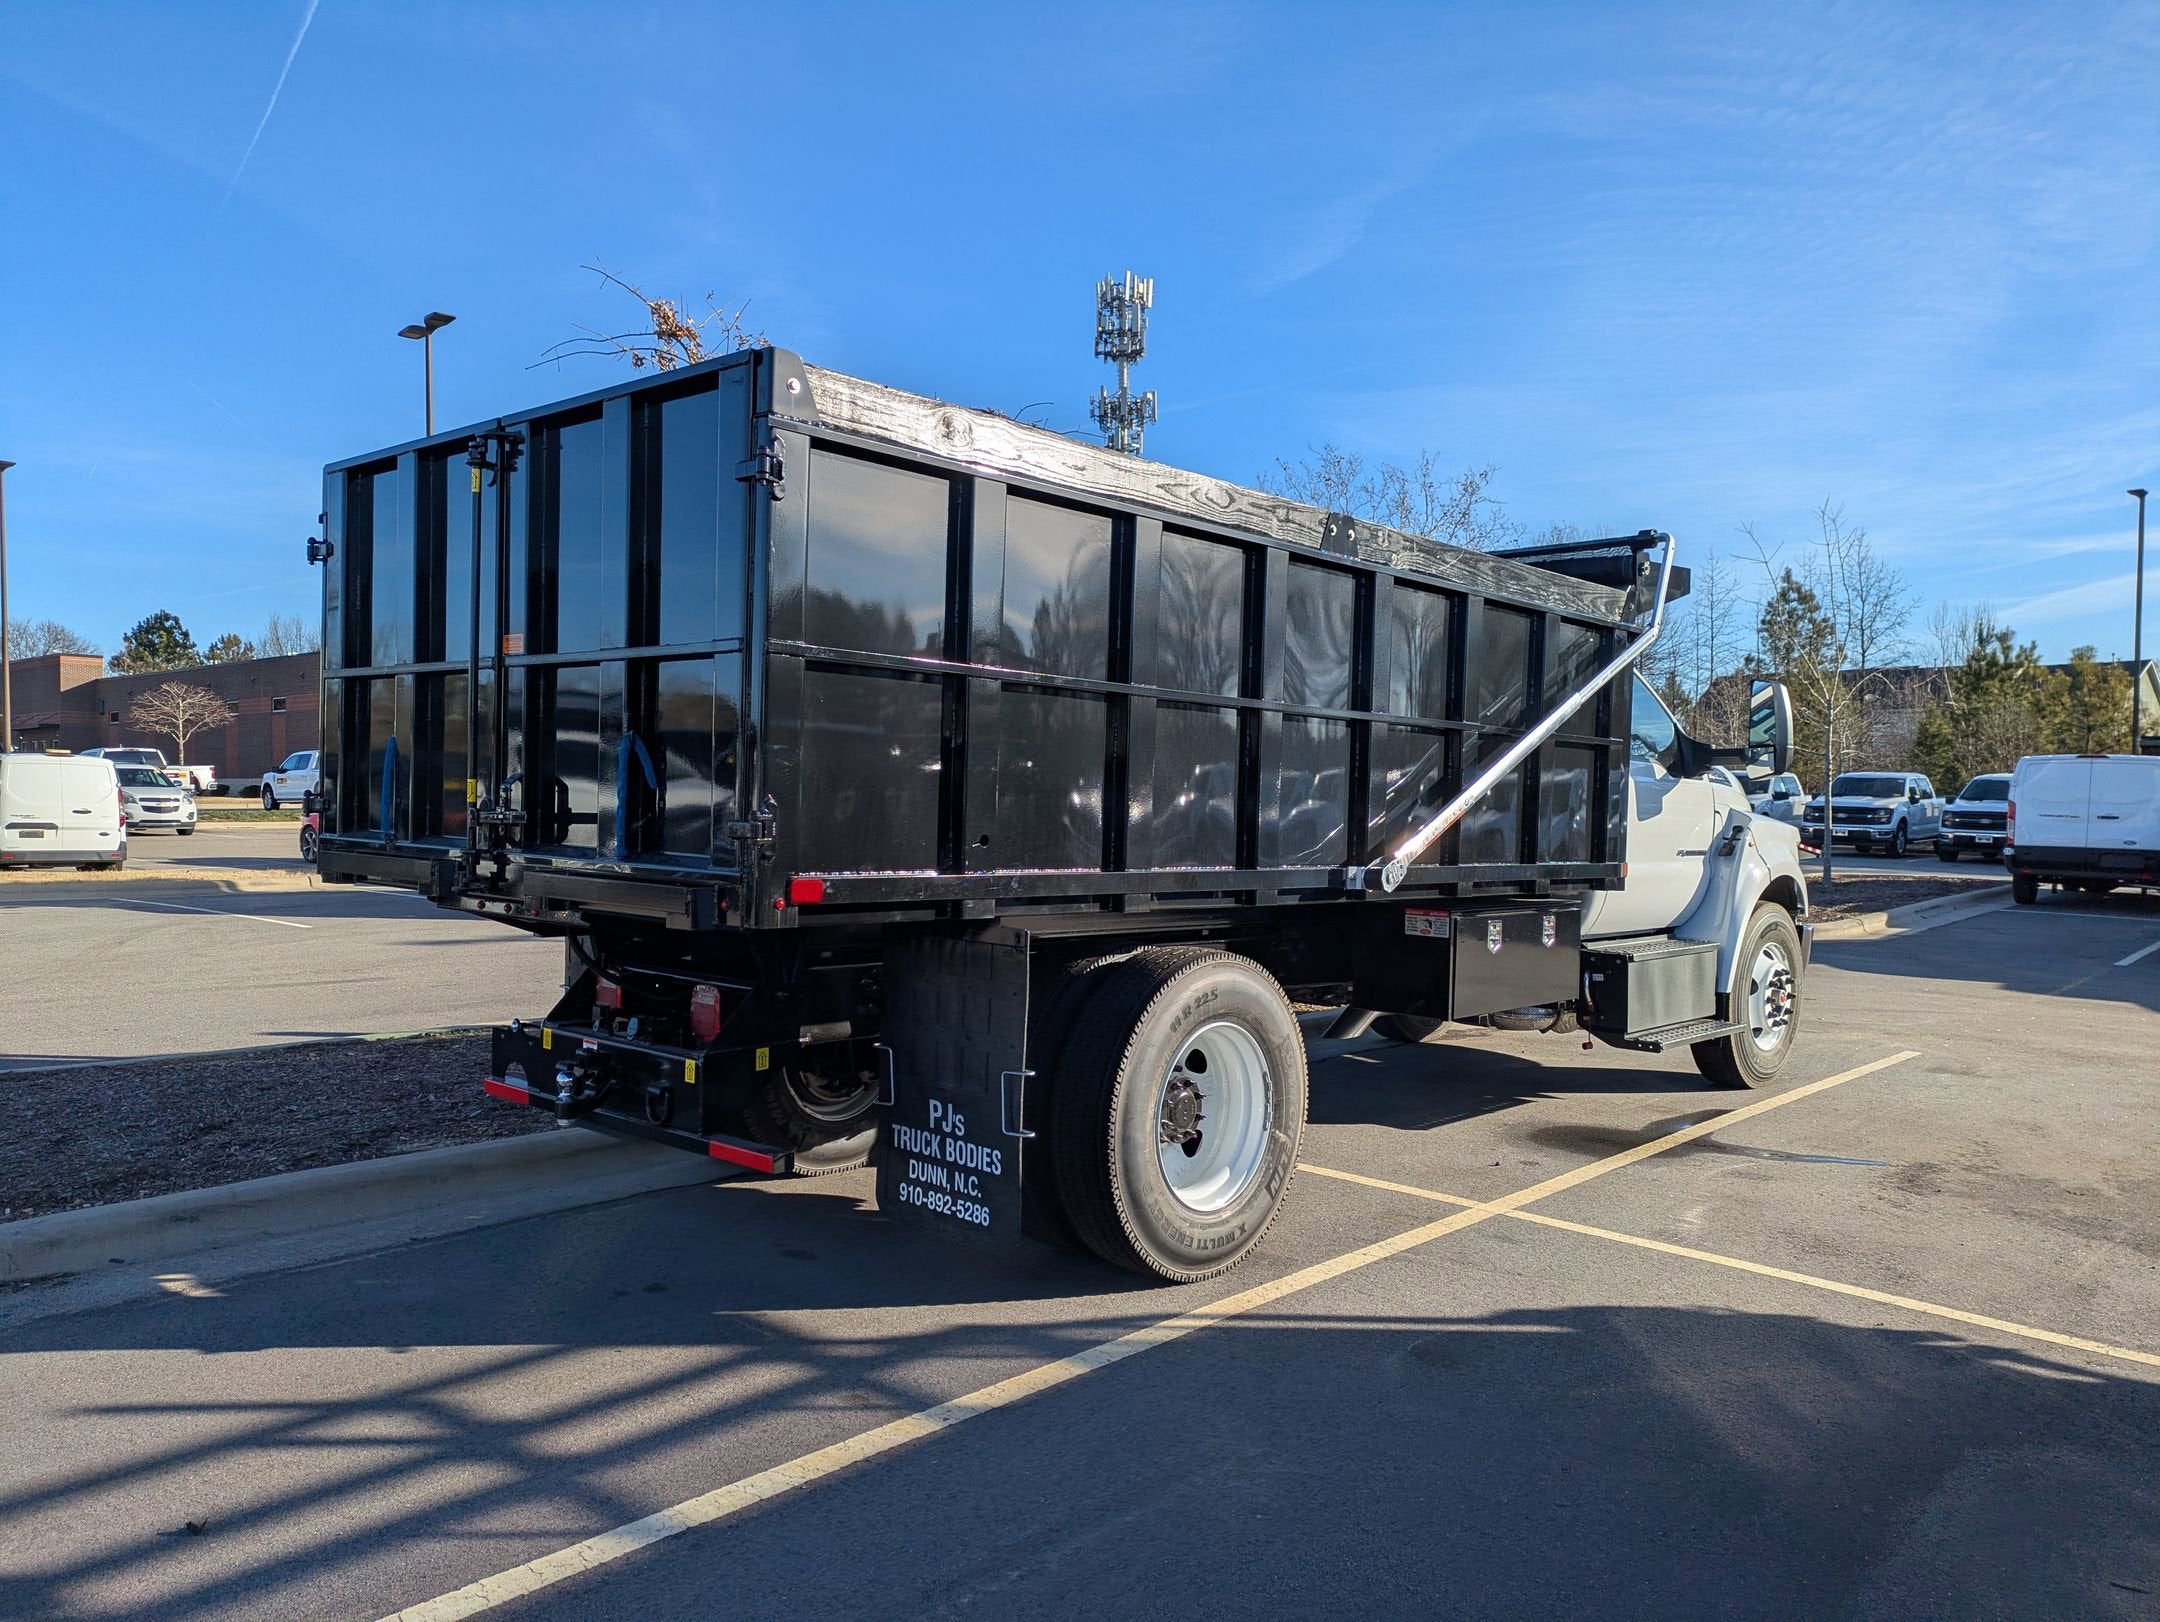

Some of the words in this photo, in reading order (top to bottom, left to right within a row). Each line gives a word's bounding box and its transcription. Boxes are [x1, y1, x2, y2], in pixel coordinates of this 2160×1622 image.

[891, 1123, 942, 1159] TRUCK
[945, 1138, 1003, 1175] BODIES
[909, 1159, 952, 1193] DUNN,
[954, 1171, 983, 1198] N.C.
[899, 1182, 991, 1227] 910-892-5286
